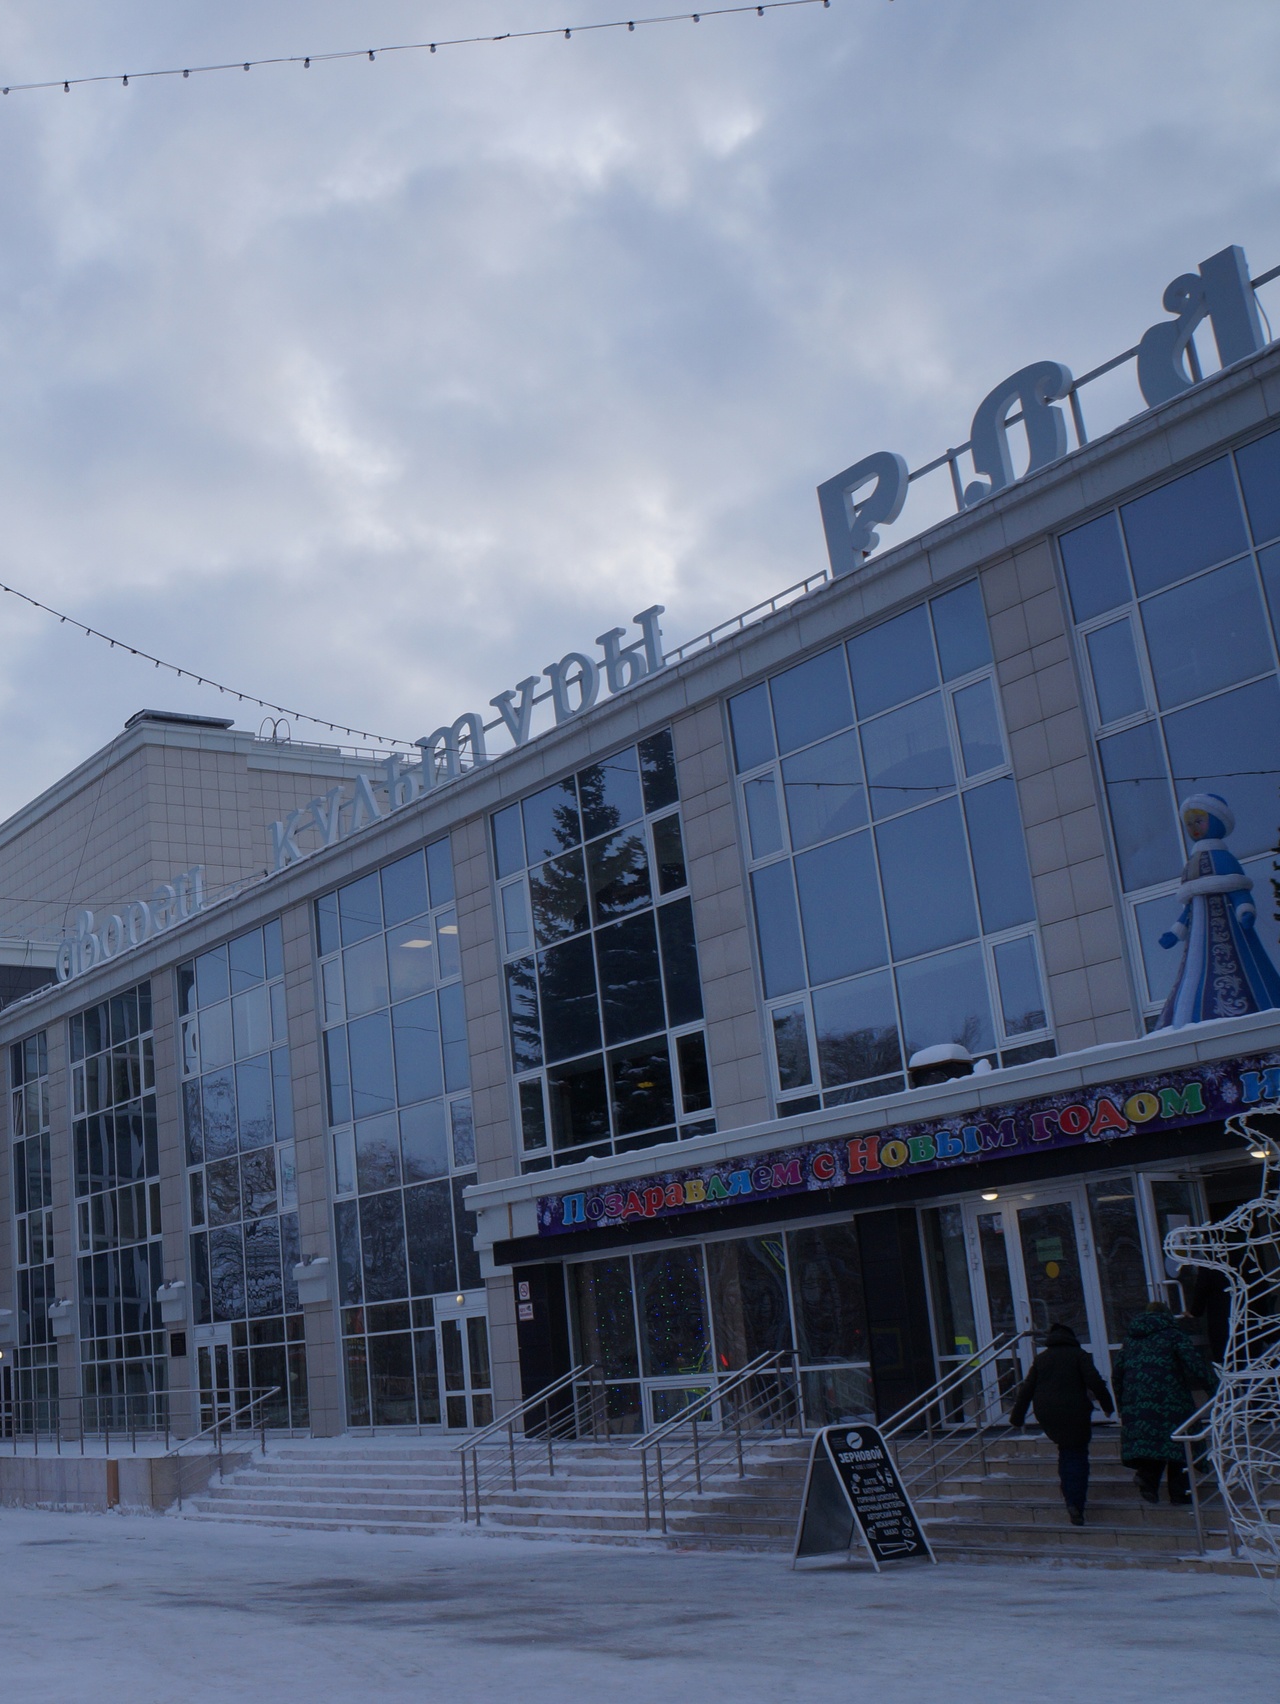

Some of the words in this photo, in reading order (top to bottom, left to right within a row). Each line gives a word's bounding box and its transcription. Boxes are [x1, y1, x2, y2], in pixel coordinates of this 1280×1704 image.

[562, 1158, 802, 1226] Поздравляем
[812, 1152, 836, 1180] с
[847, 1116, 1017, 1175] Новым
[1031, 1081, 1206, 1142] годом
[838, 1445, 884, 1463] ЗЕРНОВОЙ
